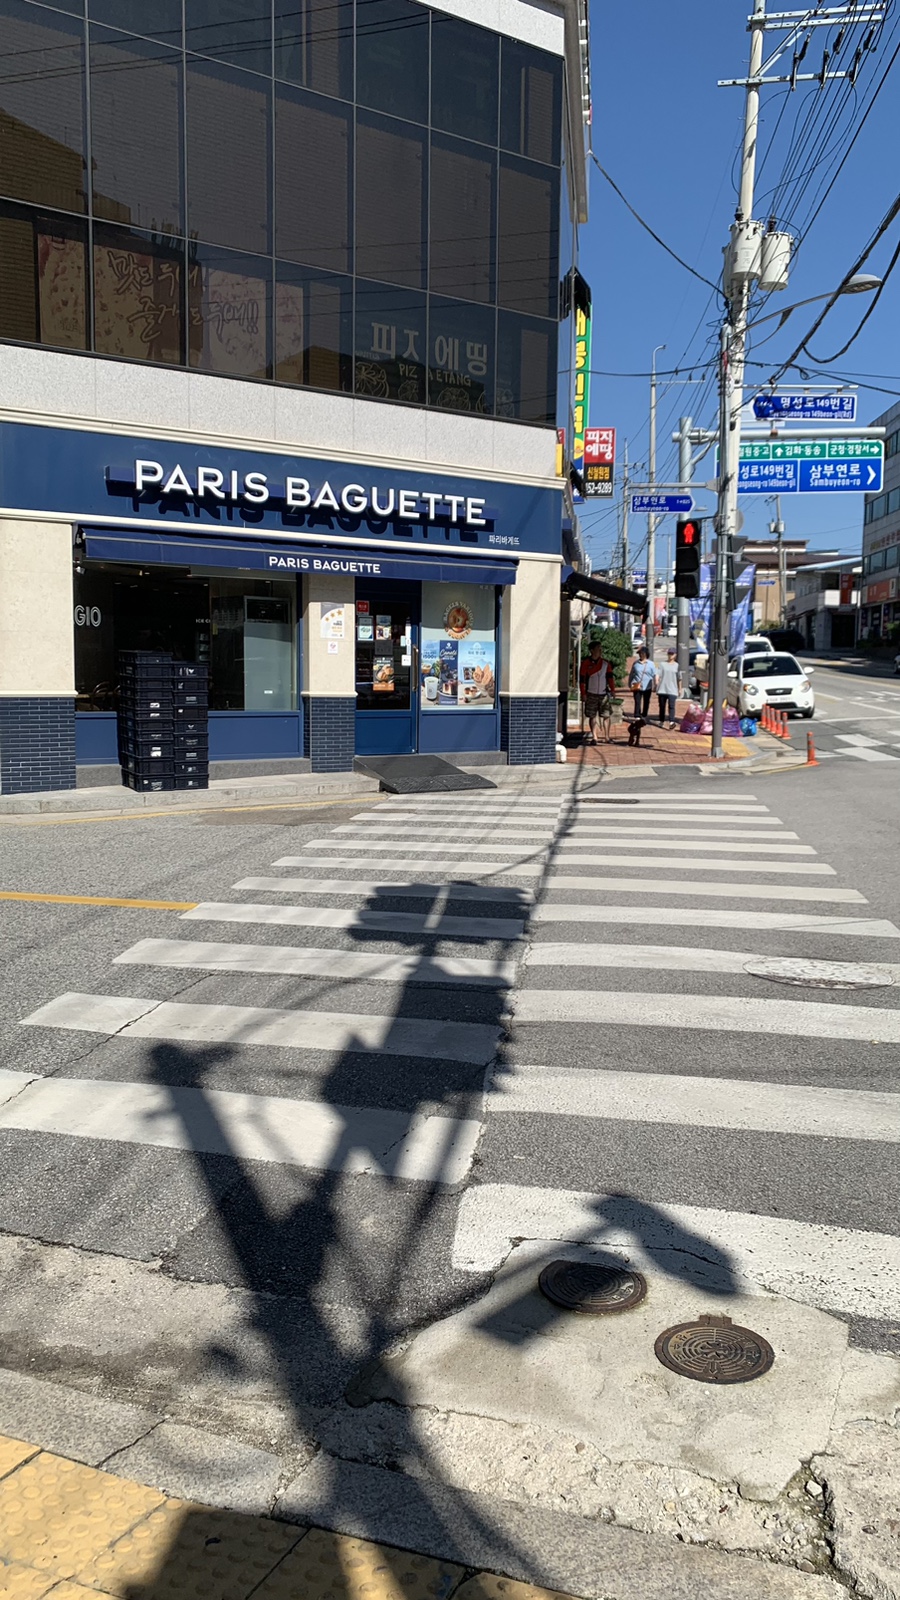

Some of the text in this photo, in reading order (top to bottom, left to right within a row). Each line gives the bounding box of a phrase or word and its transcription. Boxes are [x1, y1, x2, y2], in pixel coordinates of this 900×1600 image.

[127, 296, 203, 343] 즐거도
[586, 429, 613, 443] 피자
[585, 443, 613, 460] 에땅
[809, 463, 862, 479] 삼부연로
[135, 459, 486, 526] PARIS BAGUETTE
[489, 534, 520, 545] 파리바게뜨
[269, 556, 381, 574] PARIS BAGUETTE
